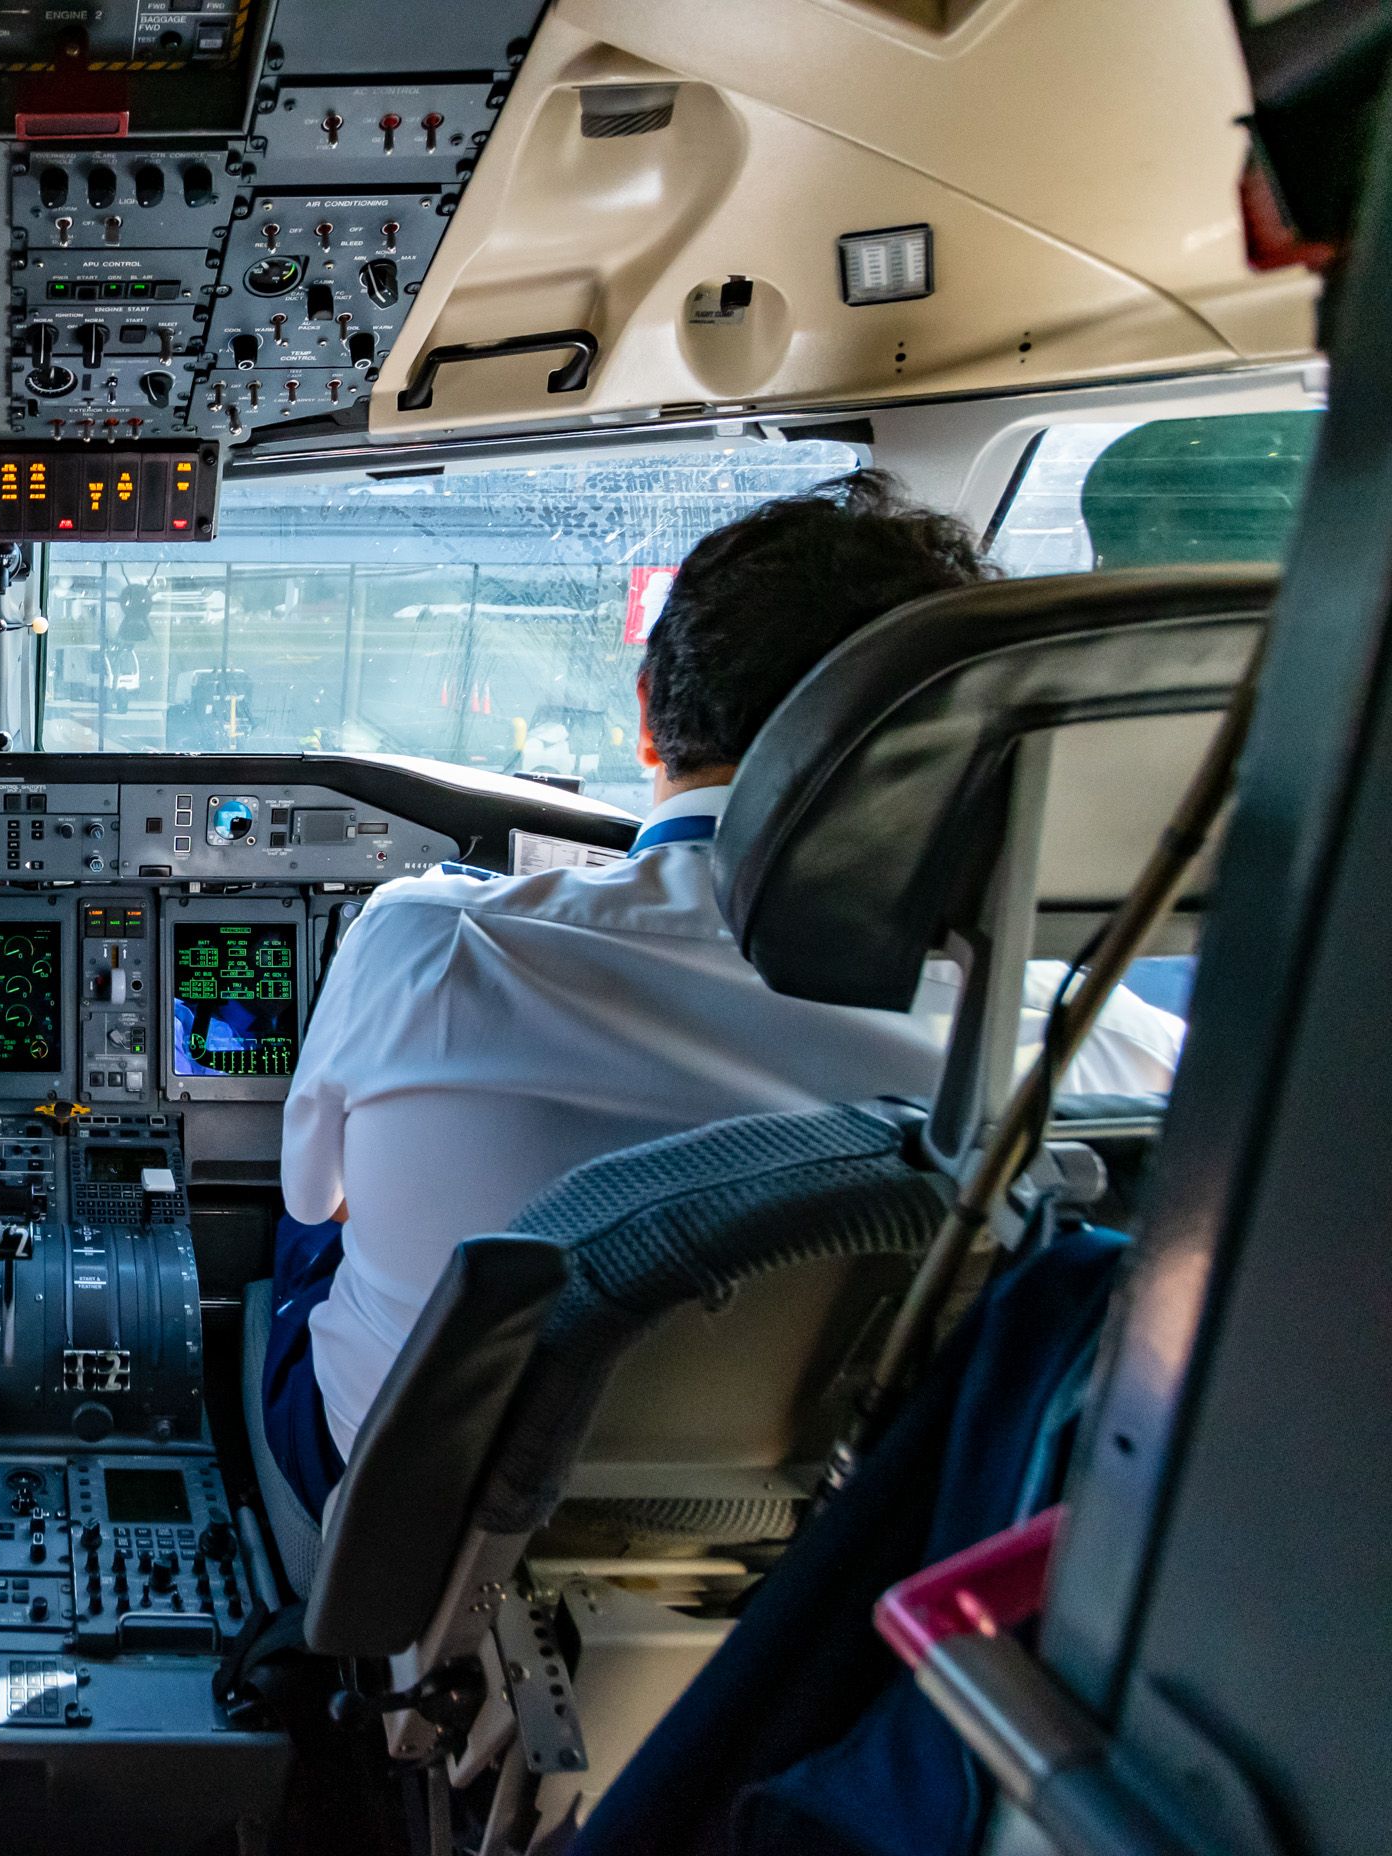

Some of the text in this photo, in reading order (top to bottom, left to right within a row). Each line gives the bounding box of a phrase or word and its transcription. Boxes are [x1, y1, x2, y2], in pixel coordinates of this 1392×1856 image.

[45, 10, 103, 20] ENGINE 2
[140, 15, 187, 23] BAGGAGE
[138, 24, 161, 32] FWD
[324, 199, 389, 207] CONDITIONING
[15, 1227, 29, 1257] 2
[105, 1353, 122, 1390] 2
